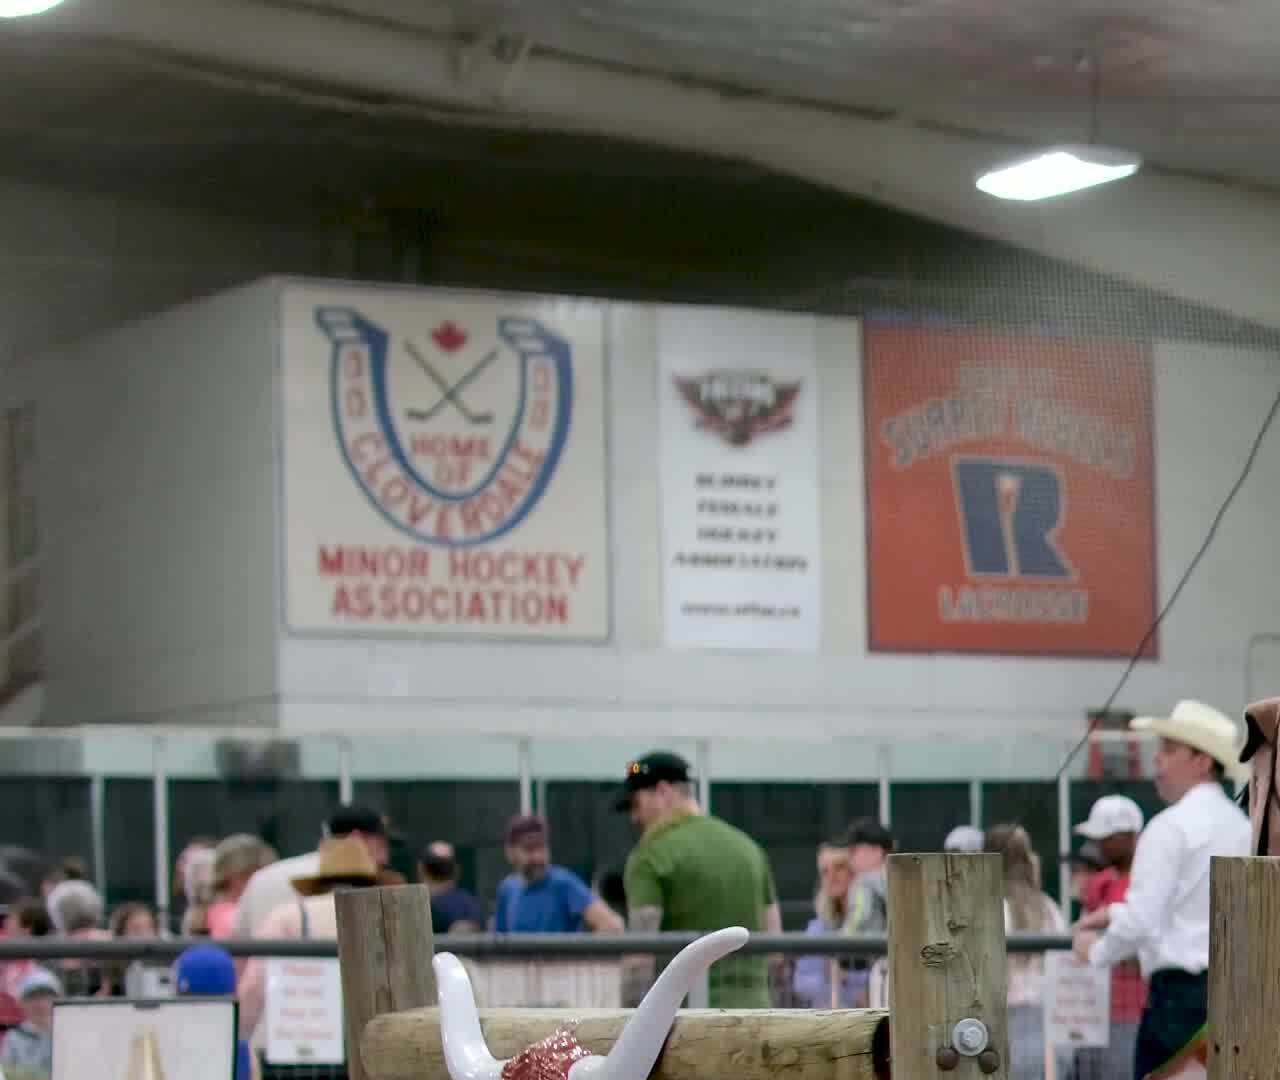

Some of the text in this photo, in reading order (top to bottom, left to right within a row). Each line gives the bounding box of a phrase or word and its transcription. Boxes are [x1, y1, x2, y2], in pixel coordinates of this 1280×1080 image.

[410, 434, 491, 460] HOME
[434, 461, 471, 485] OF
[317, 545, 585, 588] MINOR HOCKEY
[331, 583, 568, 624] ASSOCIATION
